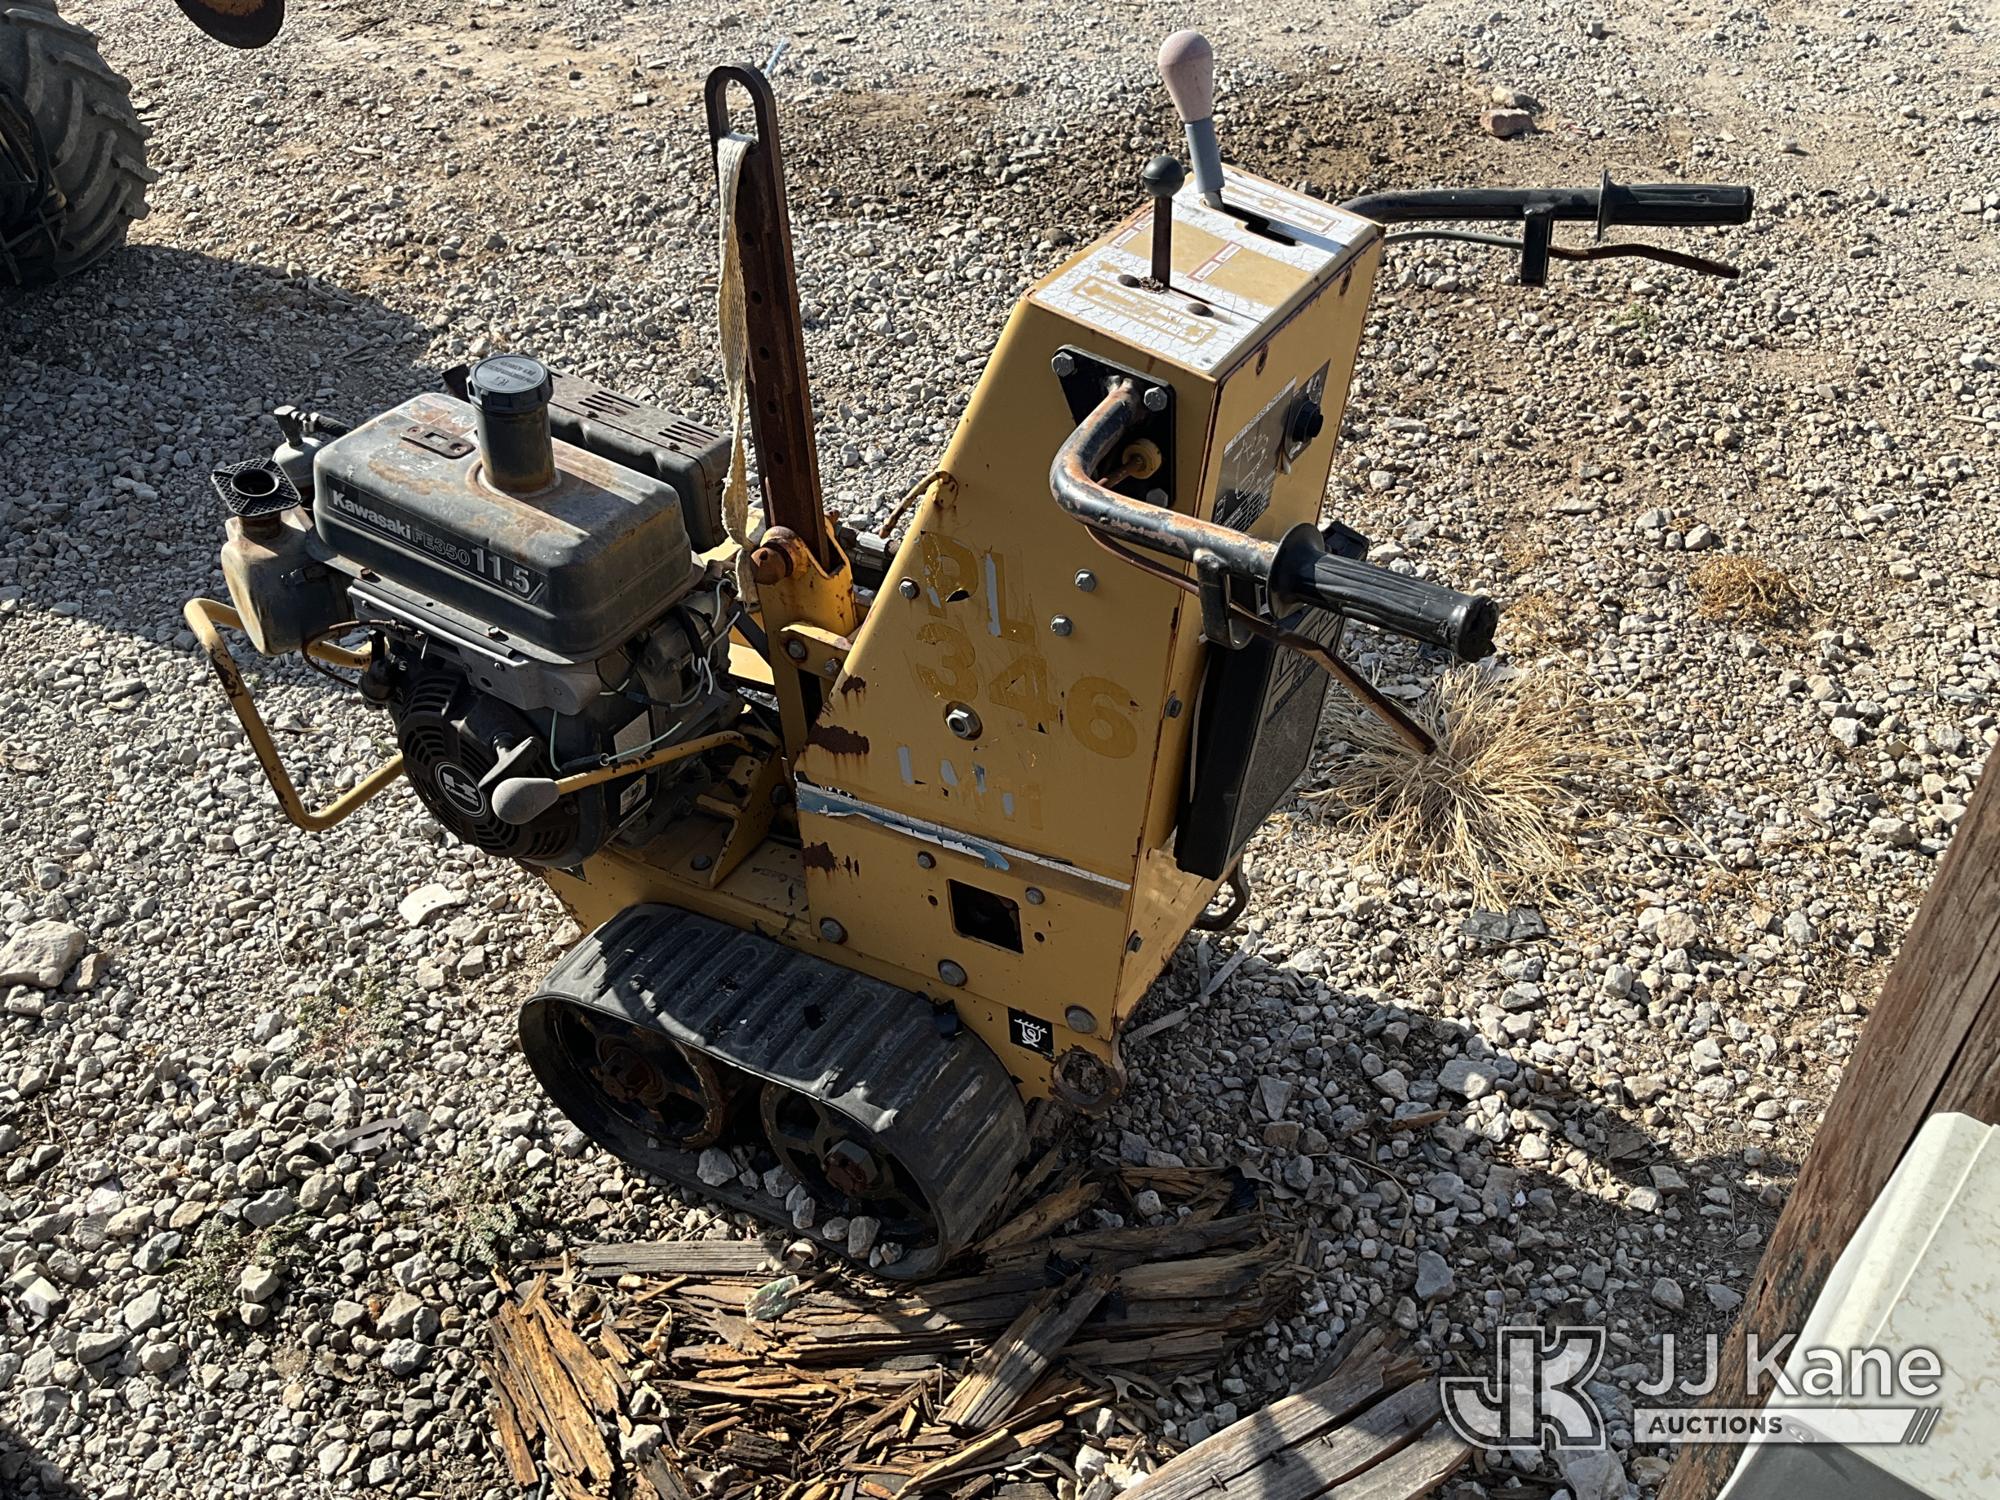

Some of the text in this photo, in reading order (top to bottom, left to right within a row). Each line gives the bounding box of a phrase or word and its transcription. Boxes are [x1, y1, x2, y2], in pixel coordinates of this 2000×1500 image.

[332, 489, 531, 594] Kawasaki FE350 11.5
[915, 623, 1139, 760] 346
